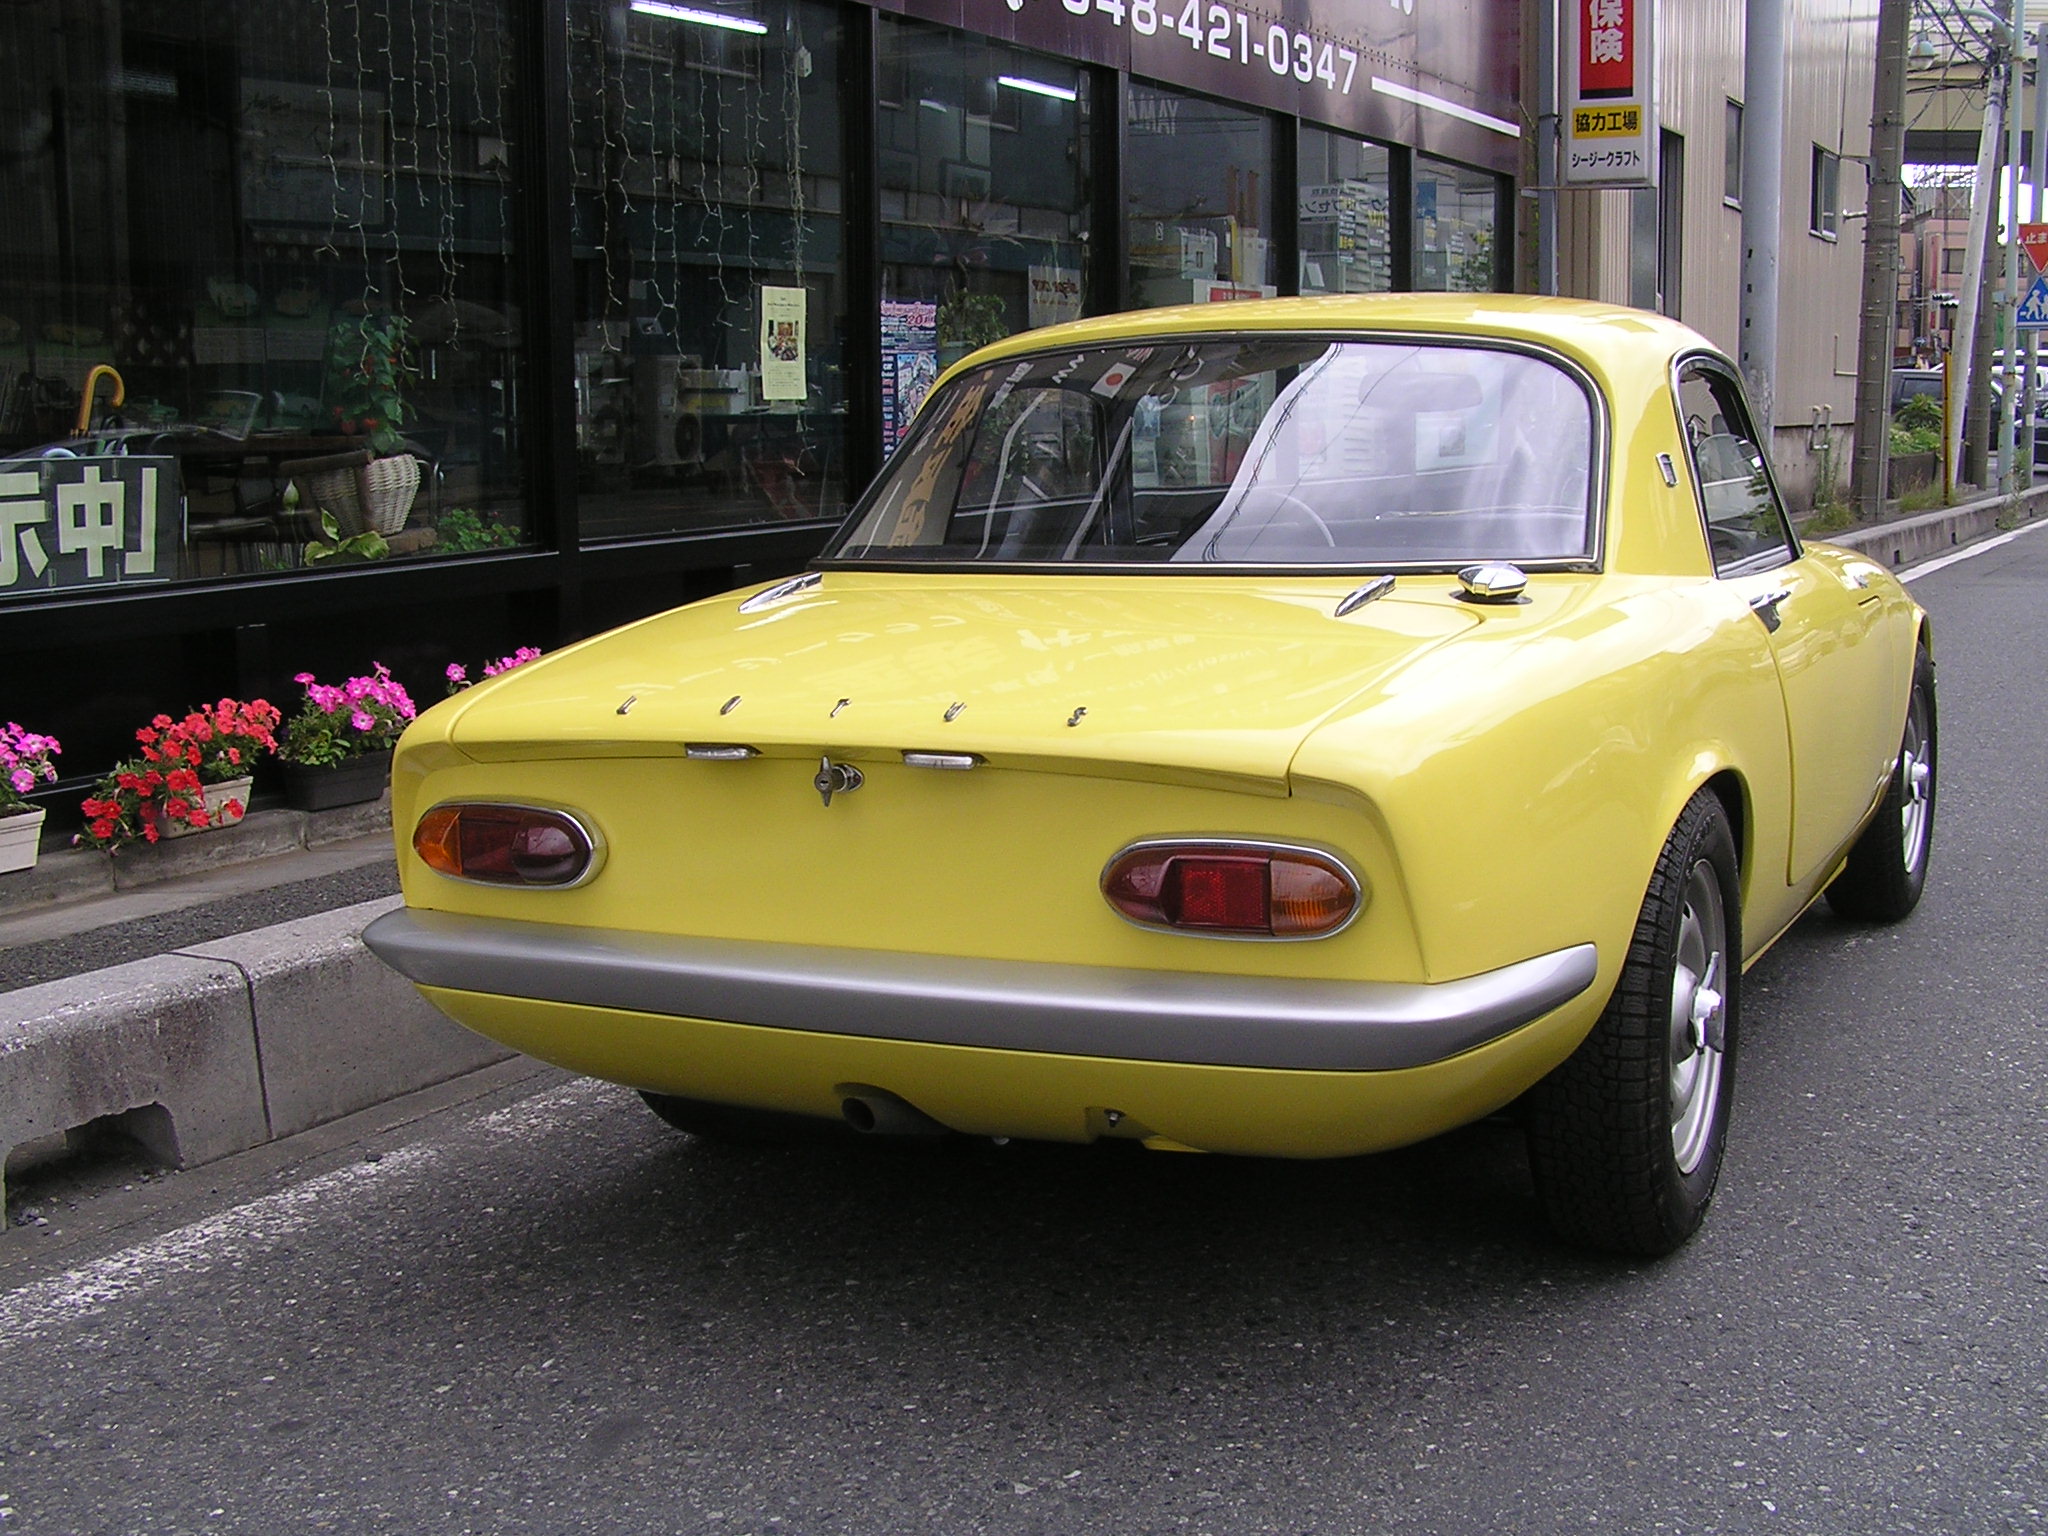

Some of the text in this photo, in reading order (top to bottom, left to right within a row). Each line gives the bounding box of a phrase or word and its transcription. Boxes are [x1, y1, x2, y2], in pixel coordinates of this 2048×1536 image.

[1589, 0, 1624, 64] 保険
[1575, 111, 1638, 132] 協力工場
[1572, 150, 1640, 167] シージークラフト
